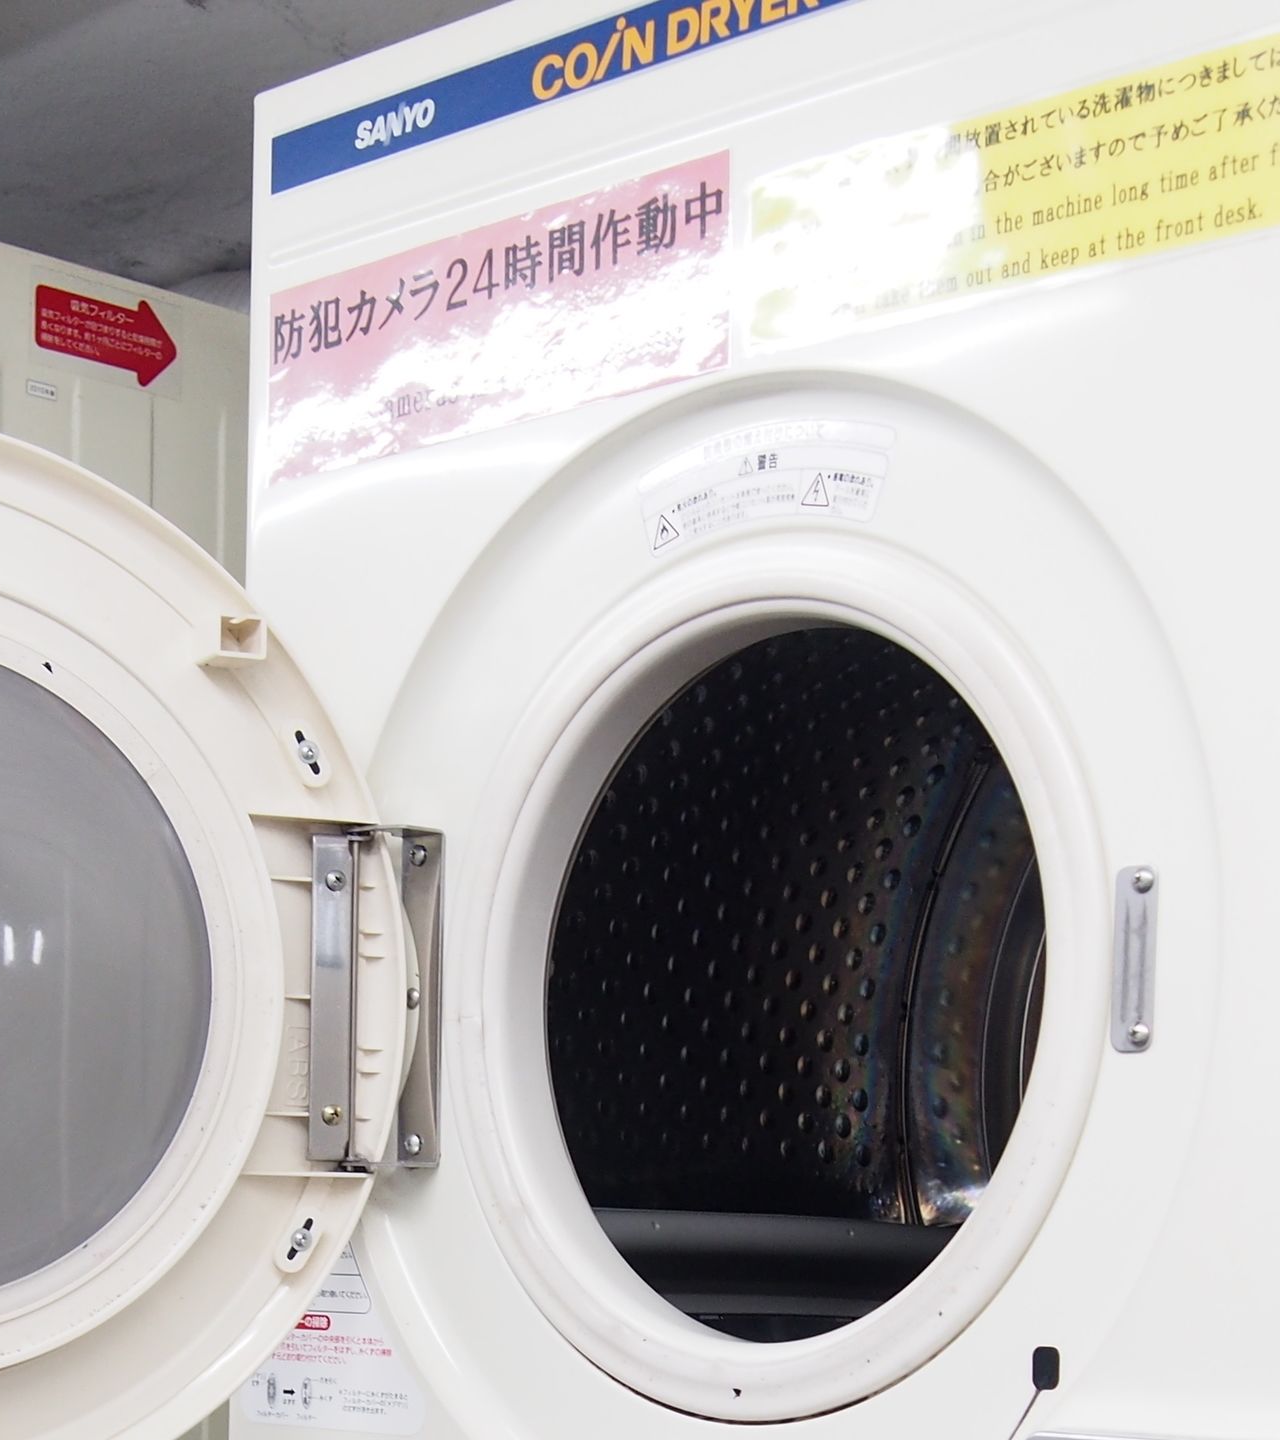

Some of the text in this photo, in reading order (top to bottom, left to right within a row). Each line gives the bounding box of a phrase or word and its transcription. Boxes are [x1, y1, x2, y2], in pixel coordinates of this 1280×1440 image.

[354, 98, 436, 151] SANYO
[995, 211, 1024, 236] the
[1032, 194, 1104, 227] machine
[1111, 178, 1150, 207] long
[1159, 171, 1200, 195] time
[1208, 151, 1260, 184] after
[273, 181, 724, 365] 防犯カメラ24時間作動中
[1000, 251, 1032, 279] and
[1039, 241, 1081, 271] keep
[1088, 235, 1107, 259] at
[1117, 225, 1146, 253] the
[1156, 211, 1204, 244] front
[1213, 198, 1264, 230] desk.
